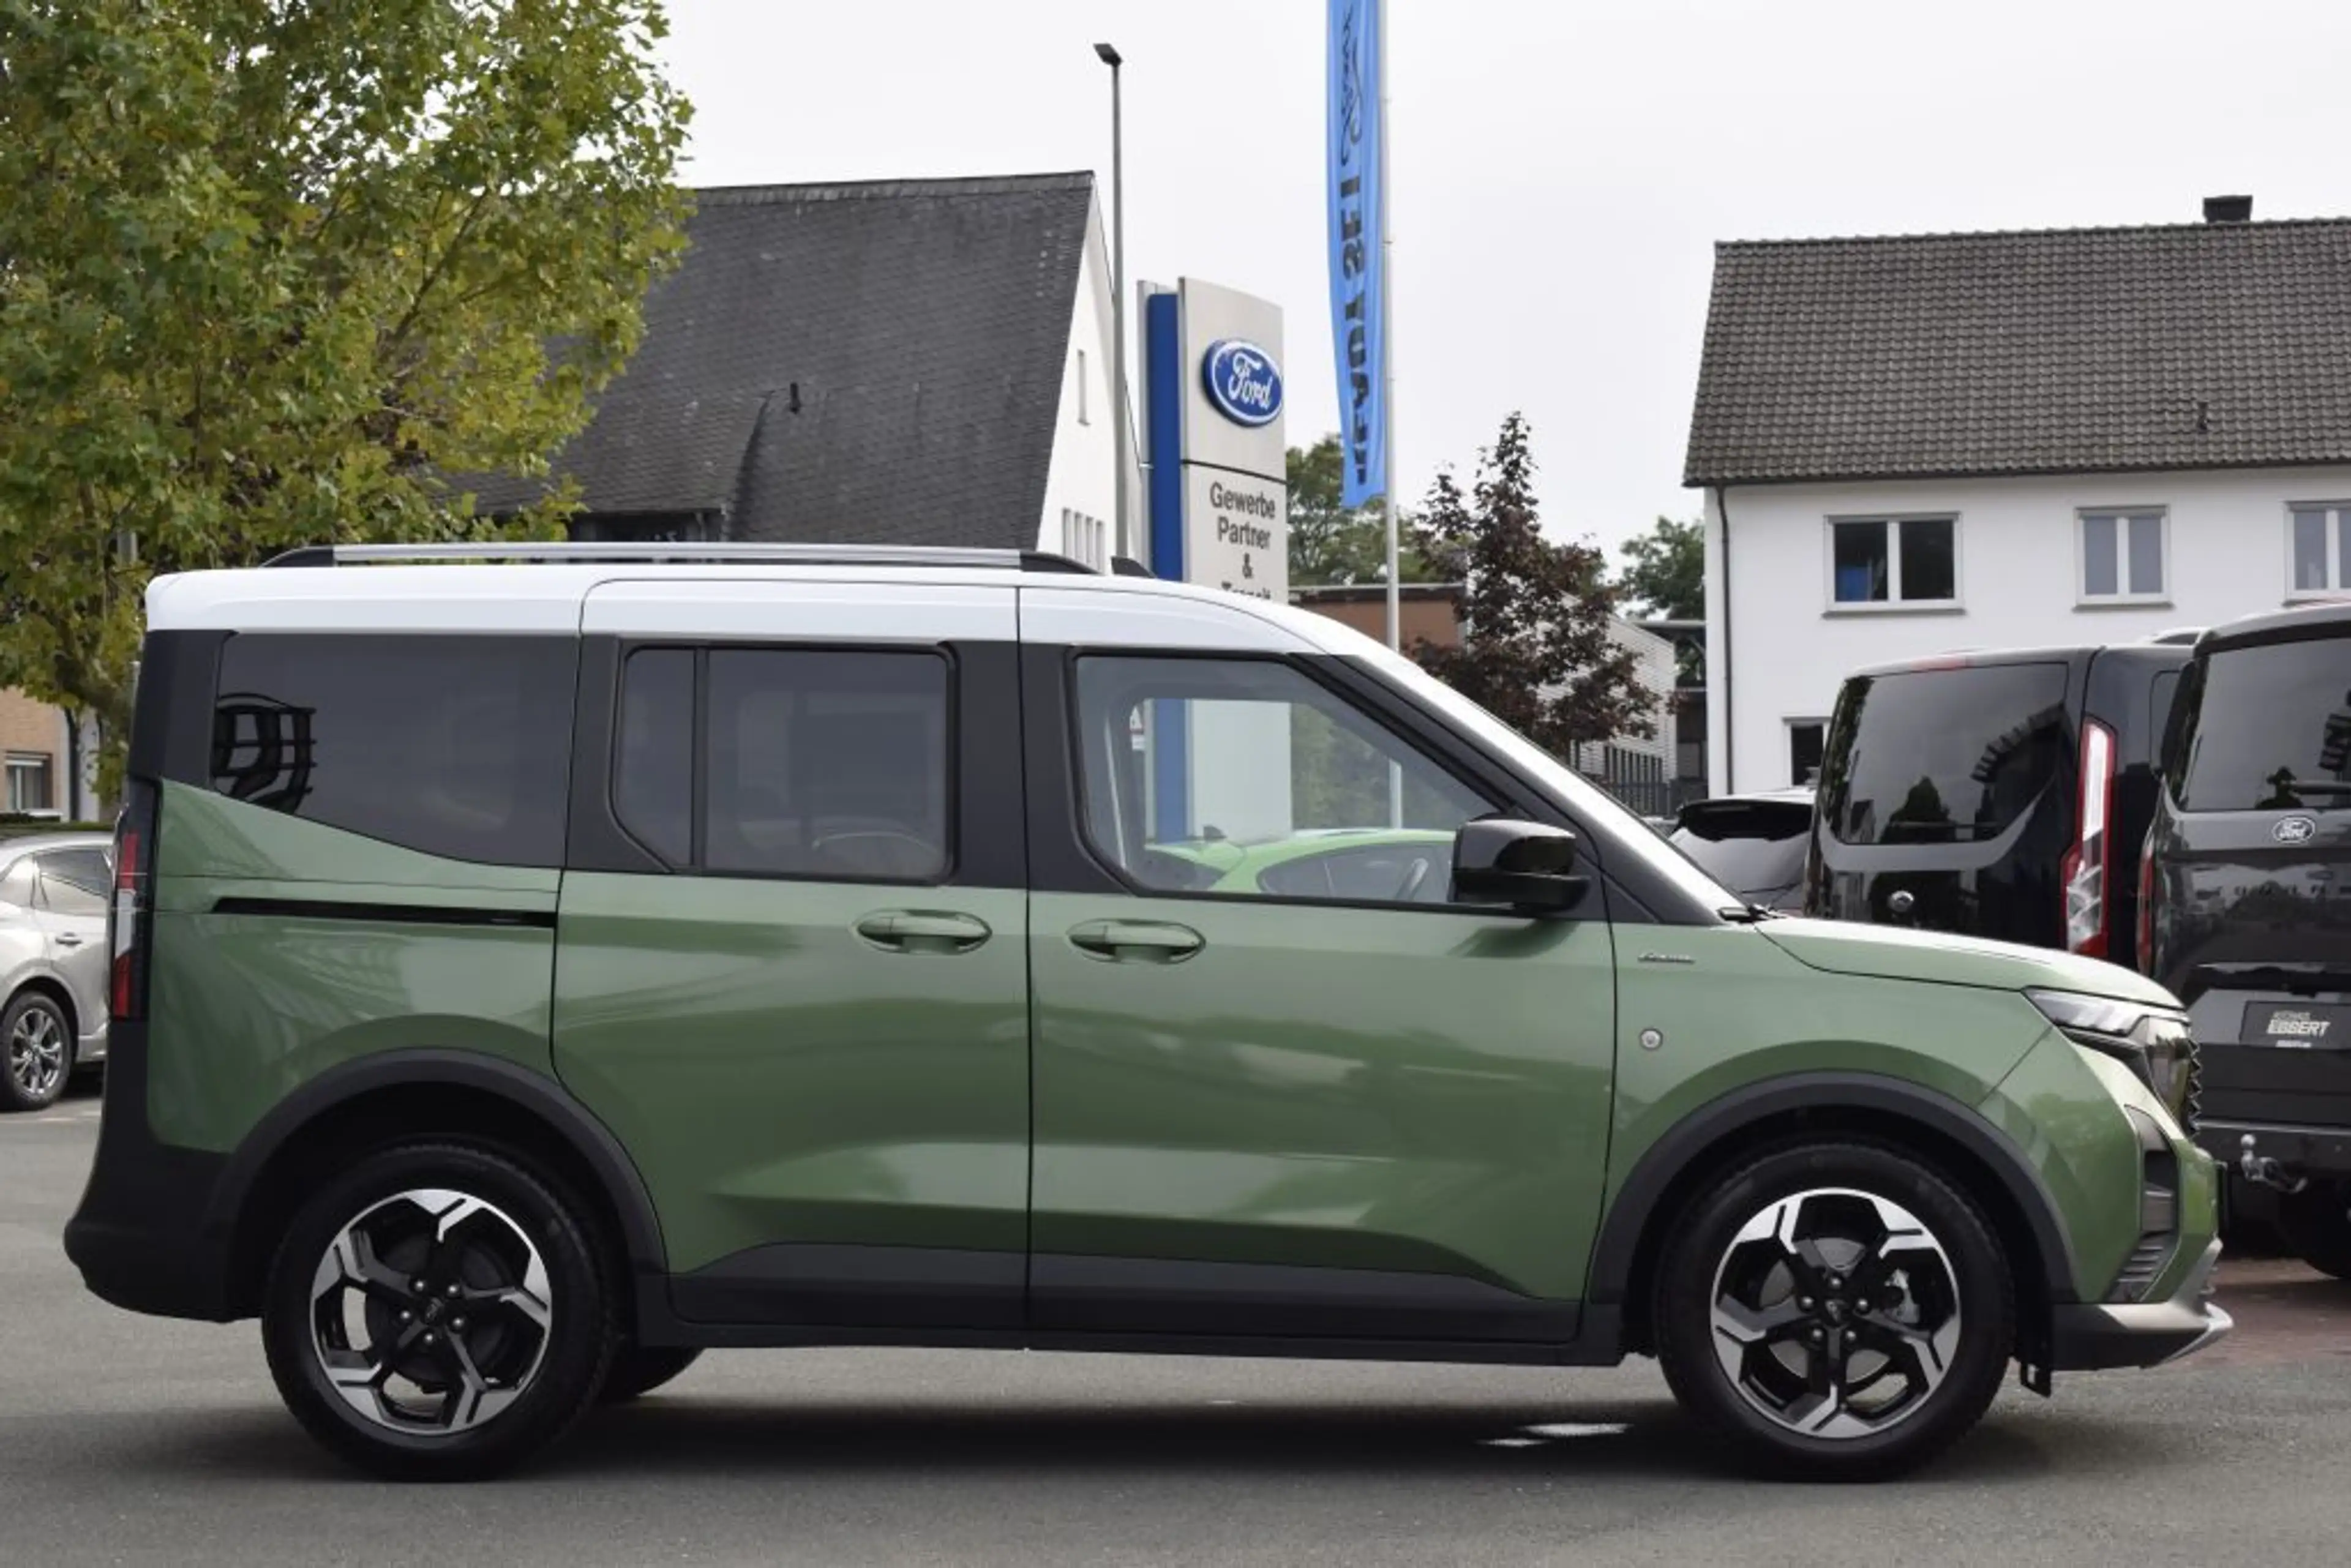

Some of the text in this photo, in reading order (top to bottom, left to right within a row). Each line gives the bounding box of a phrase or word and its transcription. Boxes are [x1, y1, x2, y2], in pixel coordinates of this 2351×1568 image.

[1228, 352, 1273, 411] Ford
[1210, 481, 1275, 519] Gewerbe
[1217, 516, 1271, 550] Partner
[1242, 553, 1253, 579] &
